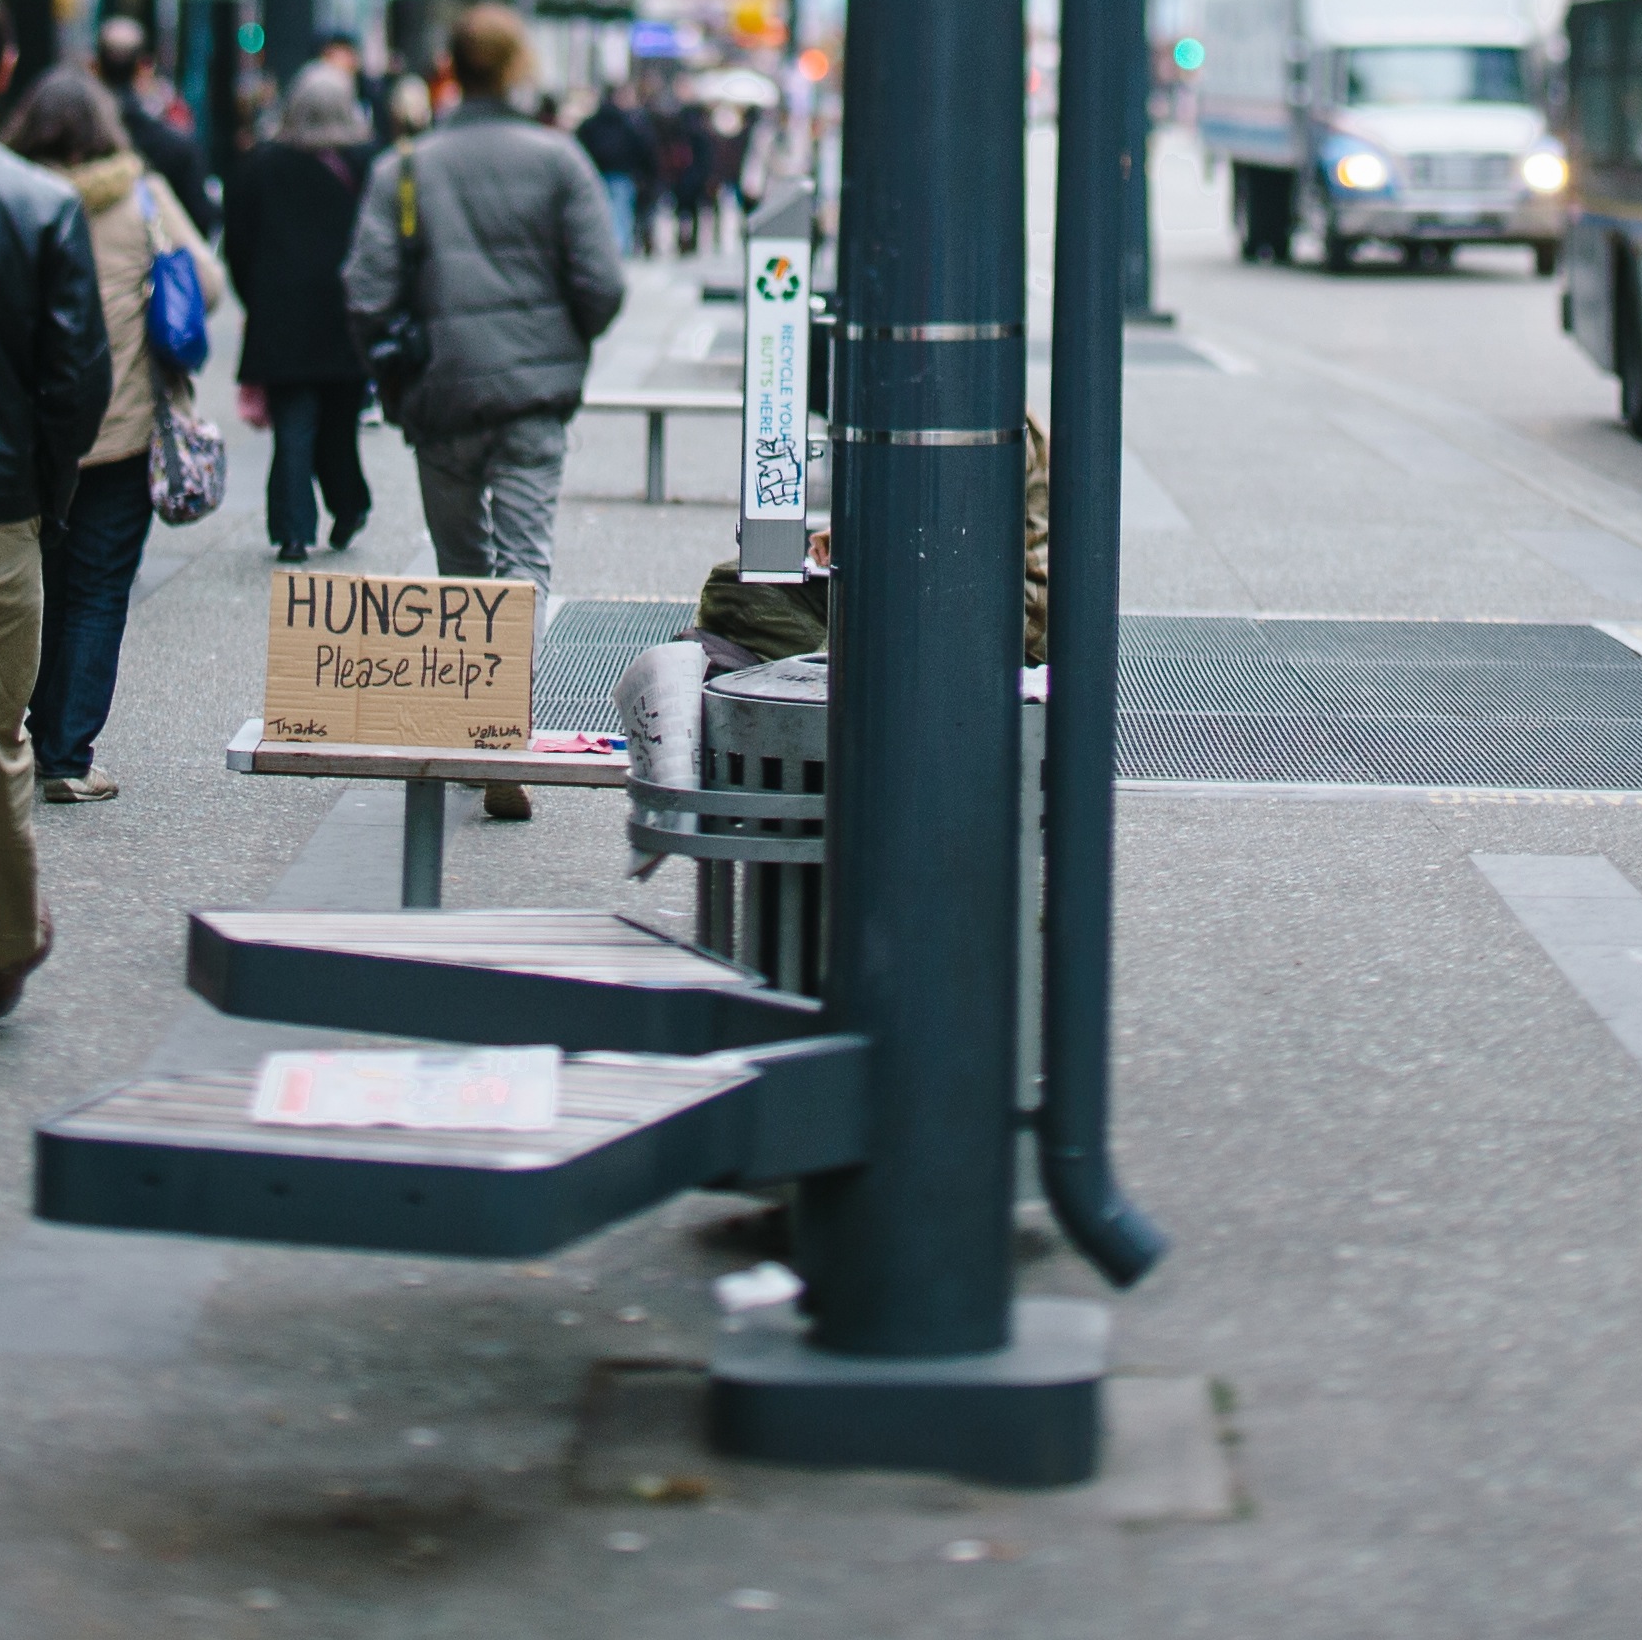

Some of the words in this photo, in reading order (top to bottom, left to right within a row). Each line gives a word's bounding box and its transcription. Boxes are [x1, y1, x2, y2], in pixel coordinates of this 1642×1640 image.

[760, 335, 774, 387] BUTTS
[780, 324, 795, 395] RECYCLE
[759, 393, 773, 435] HERE
[286, 575, 510, 643] HUNGRY
[316, 644, 412, 688] Please
[420, 644, 503, 700] Help?
[268, 717, 328, 737] Thanks
